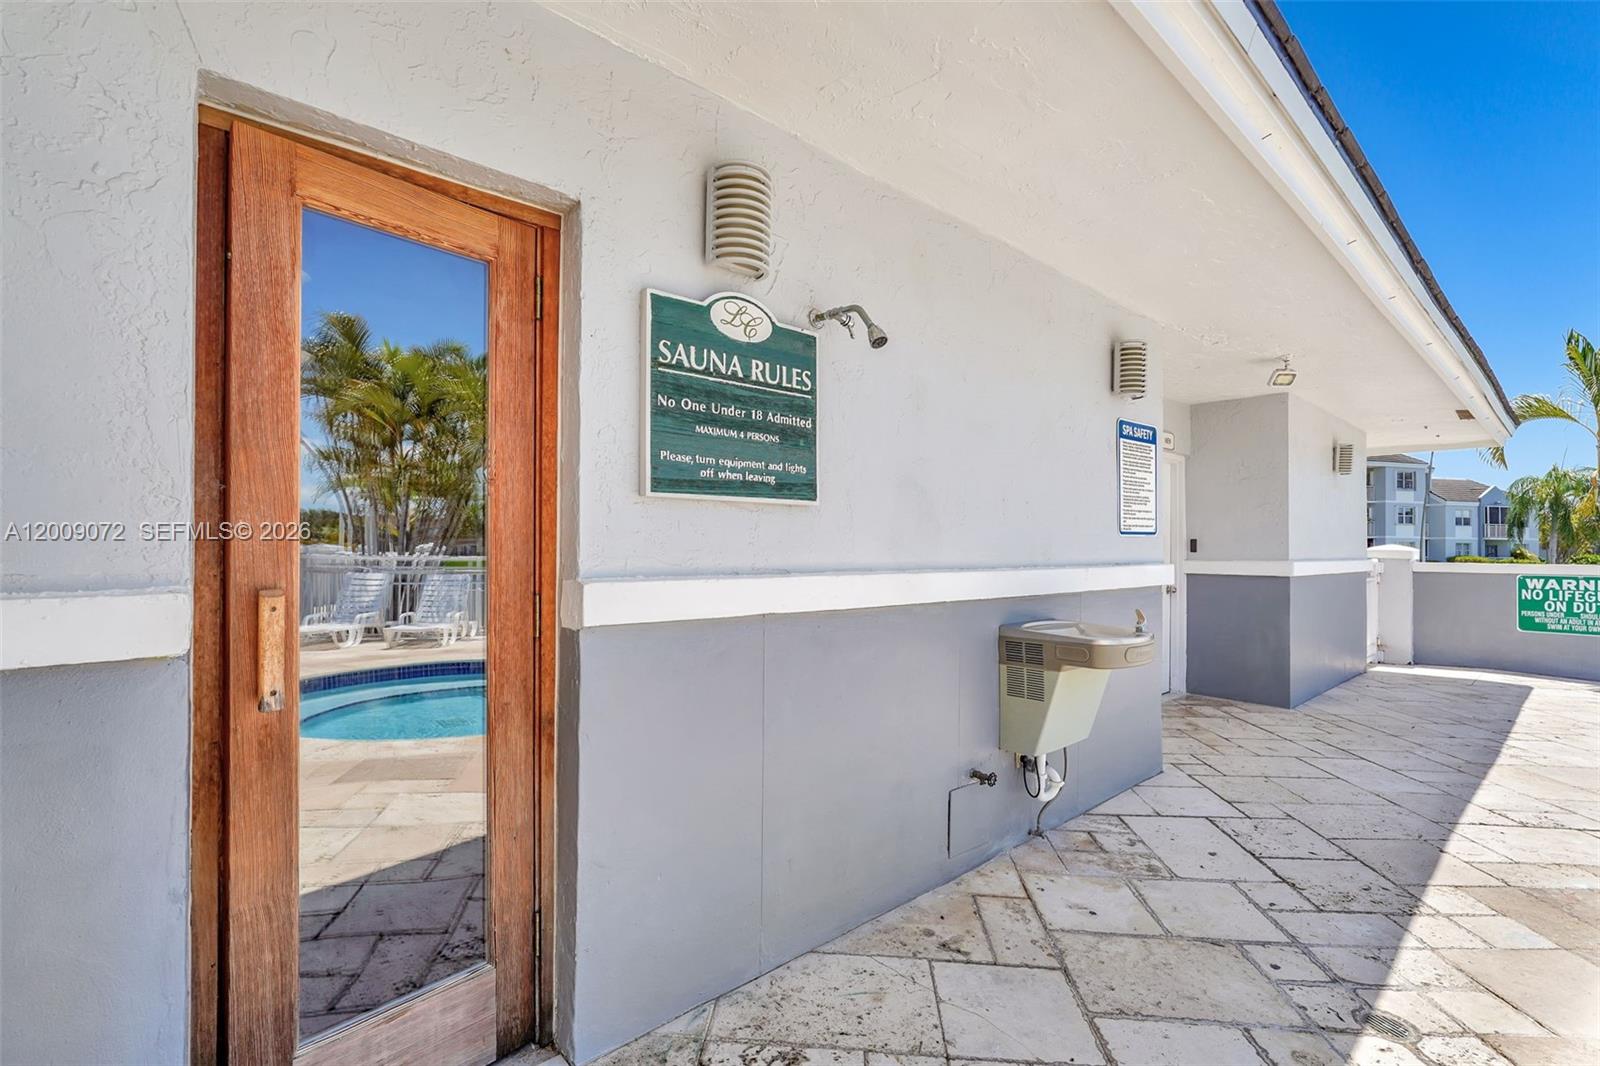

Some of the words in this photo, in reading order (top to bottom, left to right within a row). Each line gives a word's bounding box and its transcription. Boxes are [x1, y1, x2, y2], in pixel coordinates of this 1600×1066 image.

[658, 339, 743, 378] SAUNA
[751, 359, 812, 392] RULES
[657, 394, 676, 408] No
[681, 398, 706, 413] One
[711, 402, 746, 418] Under
[751, 409, 763, 420] 18
[767, 412, 812, 429] Admitted
[695, 425, 737, 439] MAXIMUM
[747, 431, 780, 444] PERSONS
[1122, 424, 1133, 438] SPA
[1133, 427, 1153, 441] SAFETY
[695, 454, 716, 465] turn
[718, 457, 765, 471] equipment
[767, 462, 783, 472] and
[785, 462, 807, 475] lights
[700, 468, 714, 478] off
[717, 470, 743, 481] when
[745, 470, 776, 485] leaving
[1521, 589, 1543, 600] NO
[1544, 601, 1567, 612] ON
[1573, 602, 1600, 613] DU
